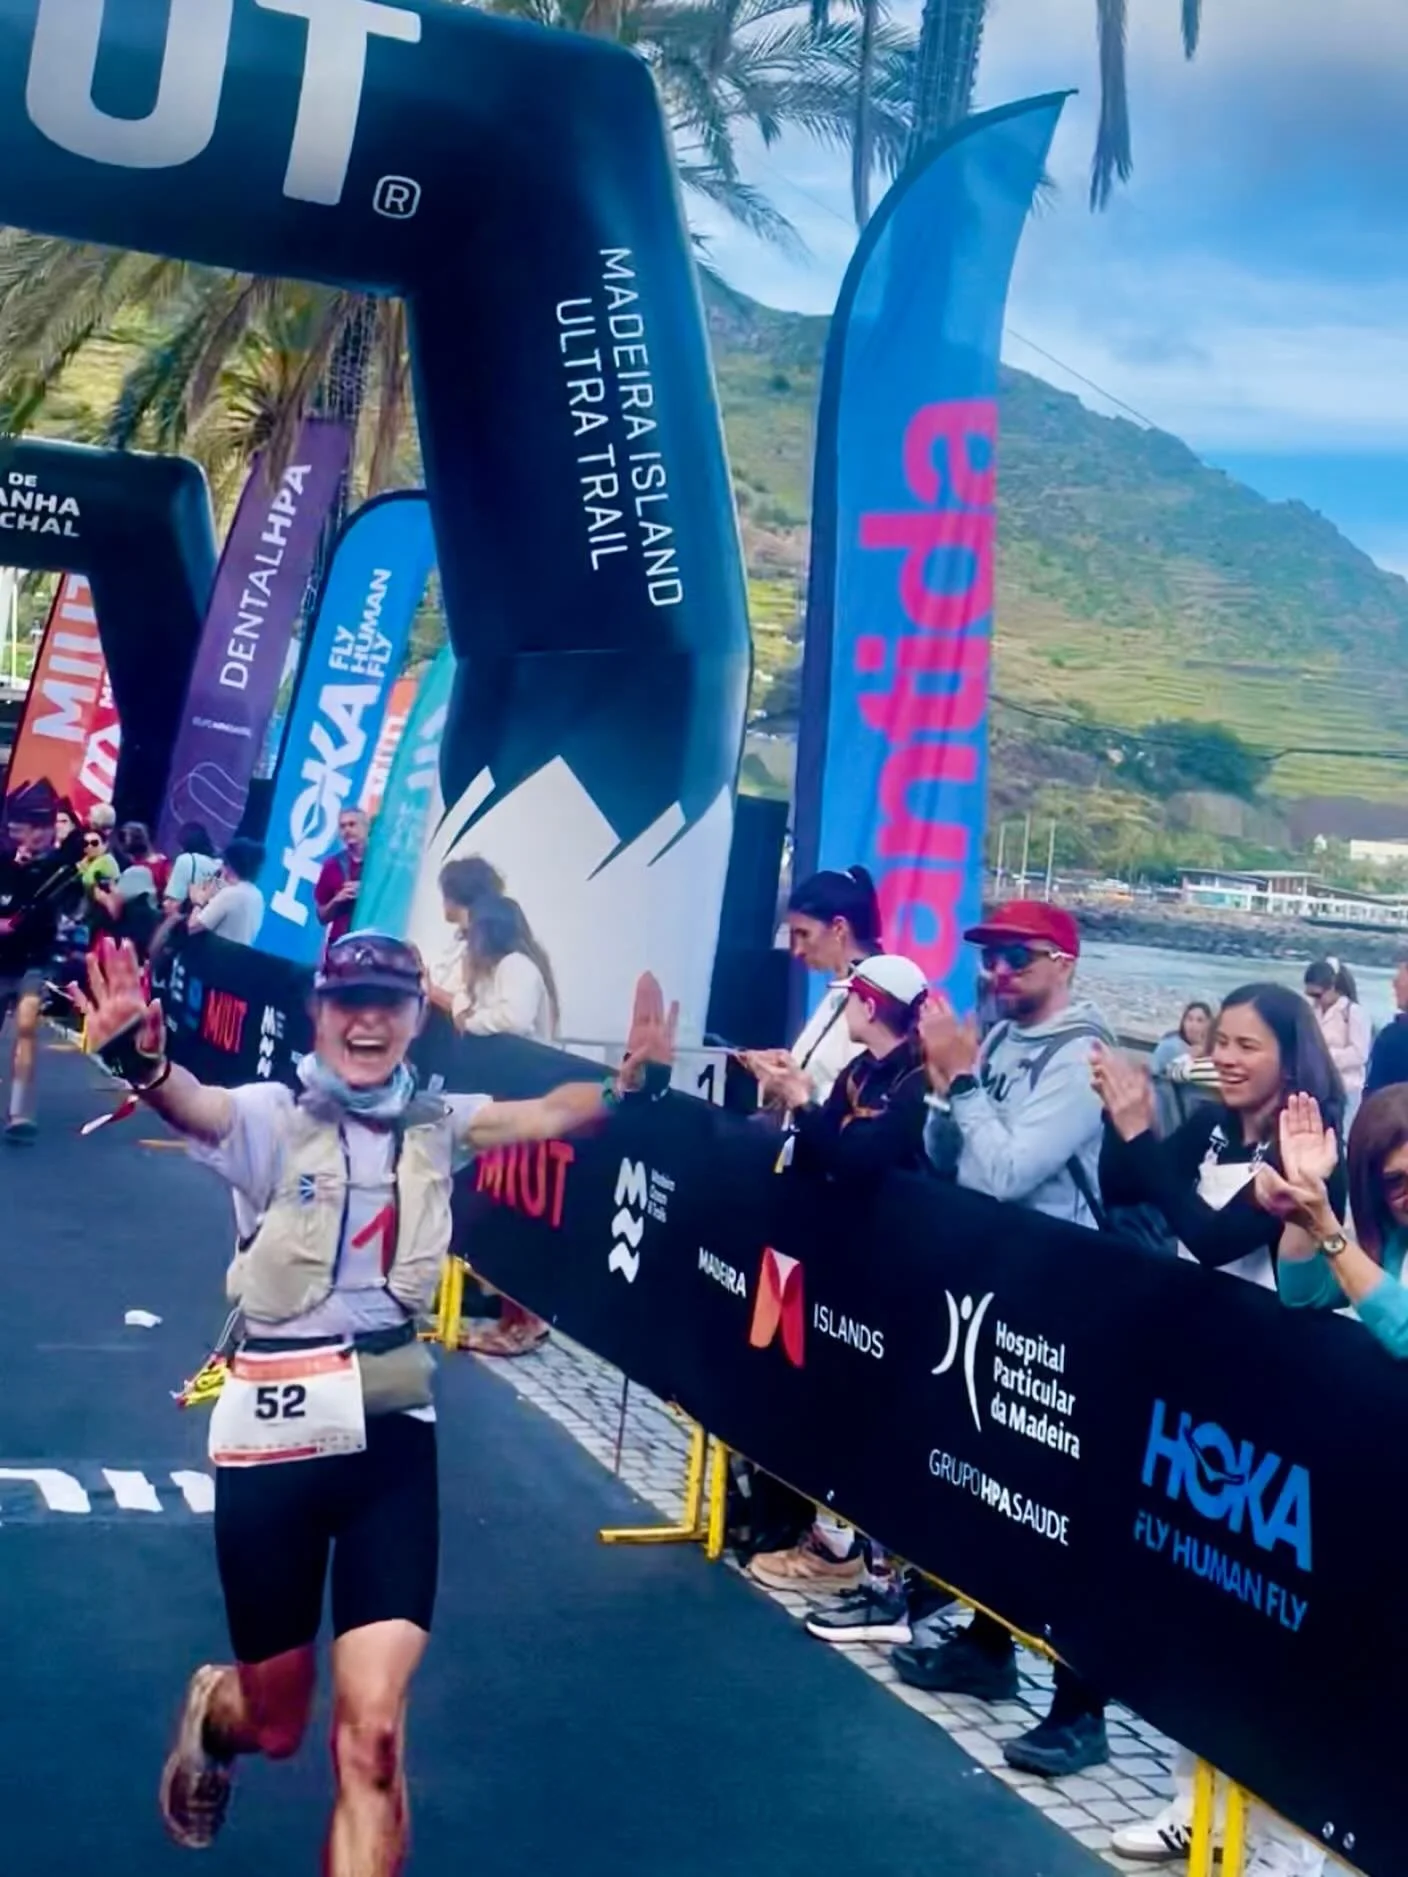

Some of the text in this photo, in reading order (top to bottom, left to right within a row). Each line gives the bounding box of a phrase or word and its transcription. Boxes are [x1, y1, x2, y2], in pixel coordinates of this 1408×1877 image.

[557, 298, 628, 571] ULTRA TRAIL
[599, 248, 683, 606] MADEIRA ISLAND
[8, 471, 38, 487] DE
[219, 464, 312, 690] DENTALHPA
[350, 569, 391, 674] HUMAN
[329, 625, 355, 671] FLY
[367, 631, 393, 678] FLY
[270, 684, 380, 927] HOKA
[476, 1138, 574, 1228] MIUT
[698, 1247, 885, 1359] MADEIRA ISLANDS
[995, 1319, 1065, 1374] Hospital
[255, 1384, 306, 1420] 52
[990, 1392, 1080, 1459] da Madeira
[993, 1356, 1076, 1416] Particular
[1141, 1398, 1312, 1572] HOKA
[1134, 1509, 1308, 1632] FLY HUMAN FLY
